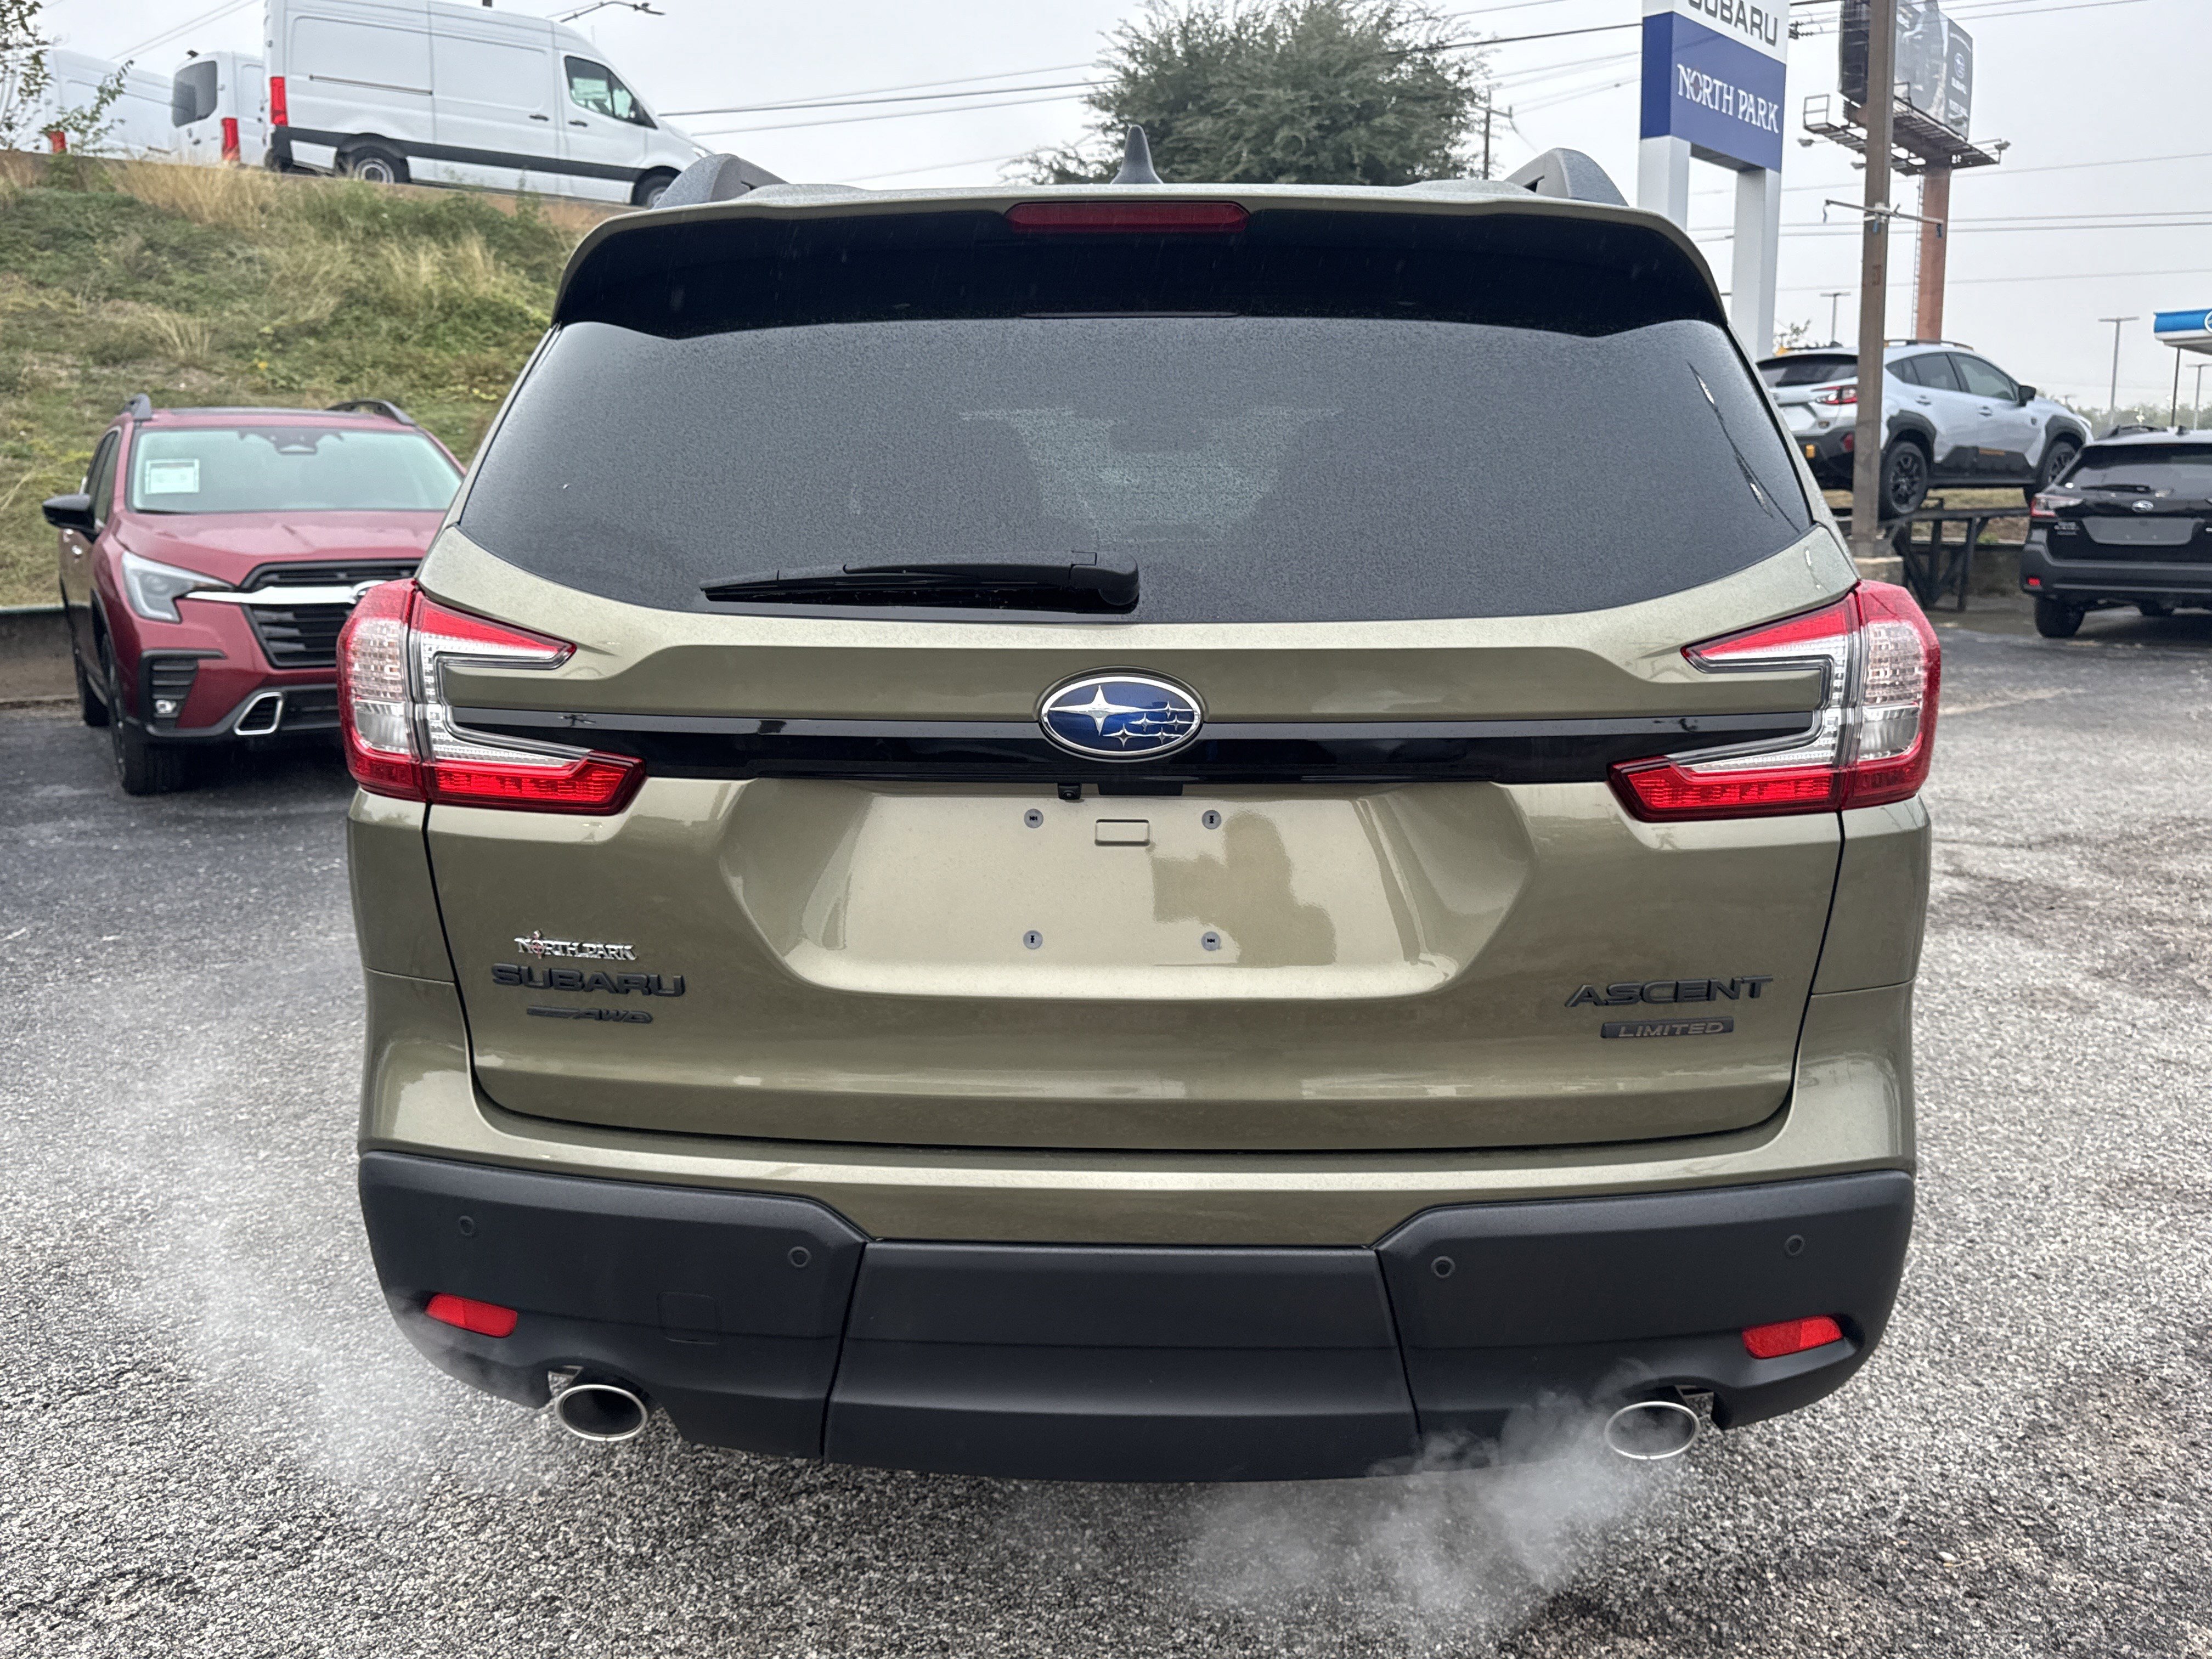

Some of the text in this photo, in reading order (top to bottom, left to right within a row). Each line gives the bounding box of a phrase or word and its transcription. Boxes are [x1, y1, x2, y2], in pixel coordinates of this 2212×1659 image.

[1688, 0, 1778, 47] UBARU
[1677, 63, 1780, 134] NORTH PARK
[514, 936, 638, 961] NORTH PARK
[491, 962, 686, 997] SUBARU
[1564, 974, 1774, 1007] ASCENT
[573, 1008, 653, 1024] AWD
[1618, 1022, 1724, 1038] LIMITED
